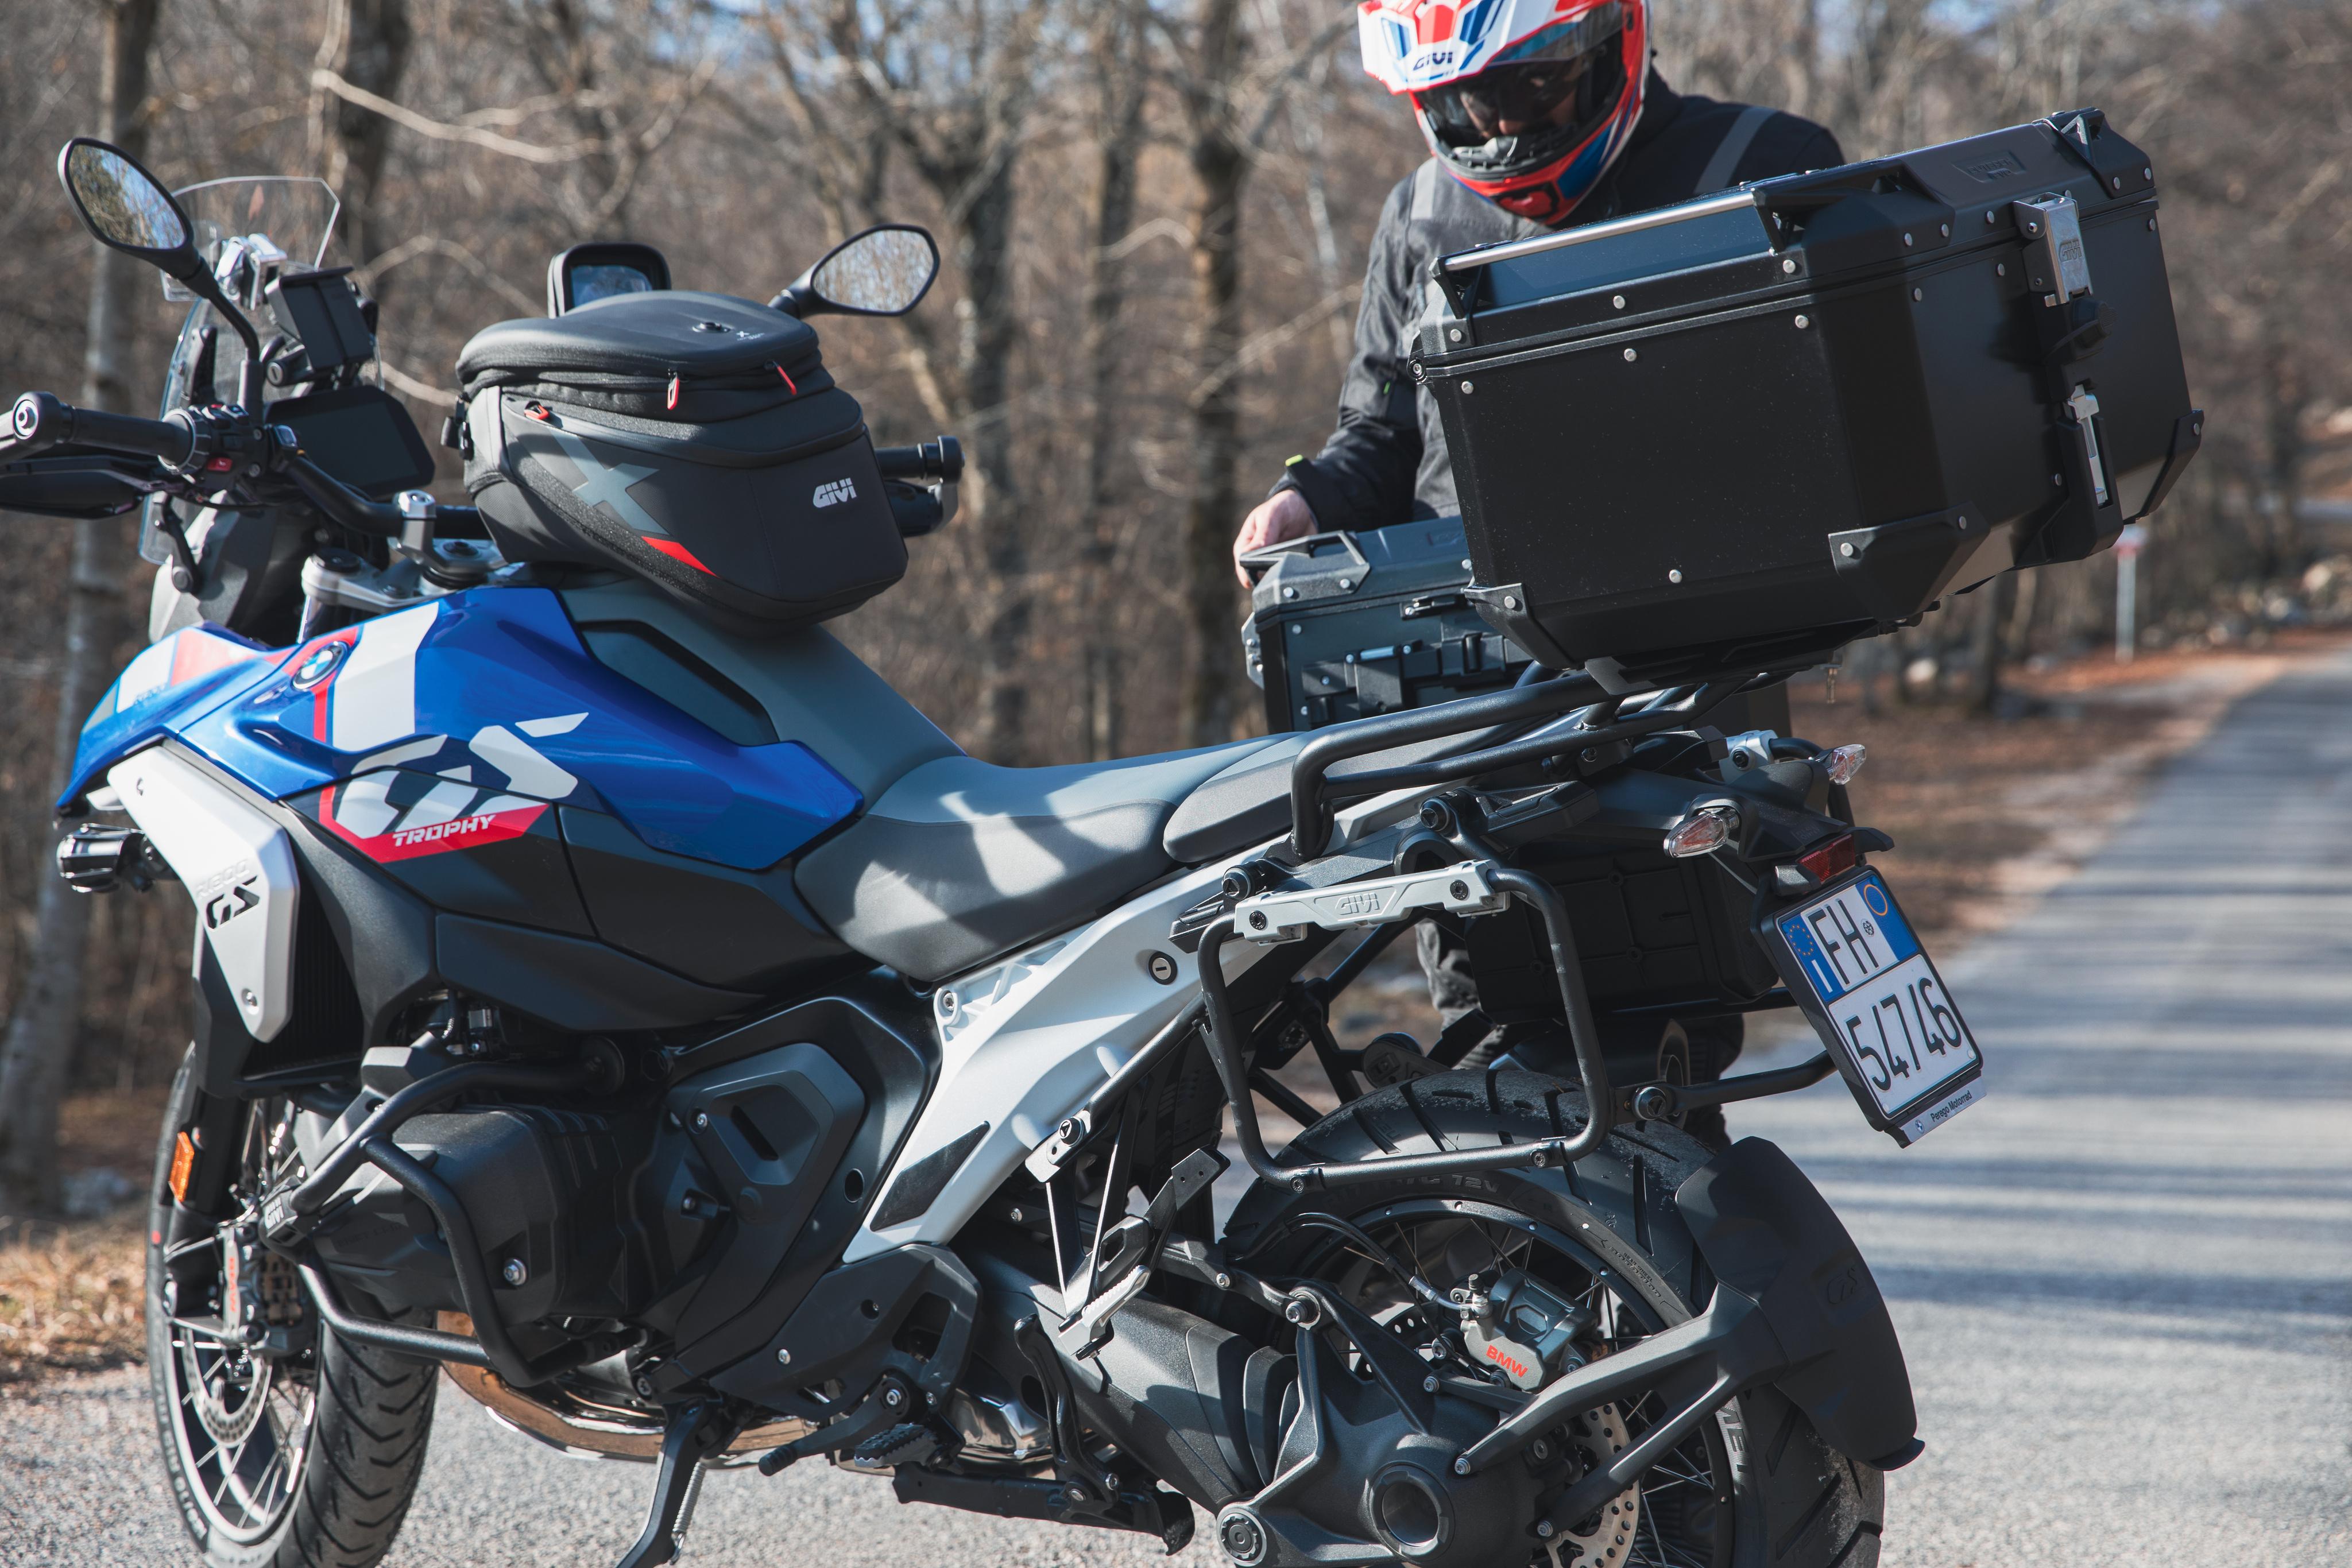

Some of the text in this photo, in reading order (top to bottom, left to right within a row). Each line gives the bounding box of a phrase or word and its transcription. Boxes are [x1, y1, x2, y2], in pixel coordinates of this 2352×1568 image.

[1413, 51, 1453, 70] GIVI
[2059, 238, 2082, 262] GIVI
[813, 478, 857, 508] GIVI
[392, 814, 496, 847] TROPHY
[206, 876, 260, 929] GS
[1334, 892, 1380, 914] GIVI
[1808, 899, 1878, 985] FH
[1846, 978, 1962, 1091] 54746
[1930, 1090, 1972, 1122] Perego Motorrad
[264, 1198, 284, 1229] GIVI
[1486, 1345, 1528, 1377] BMW
